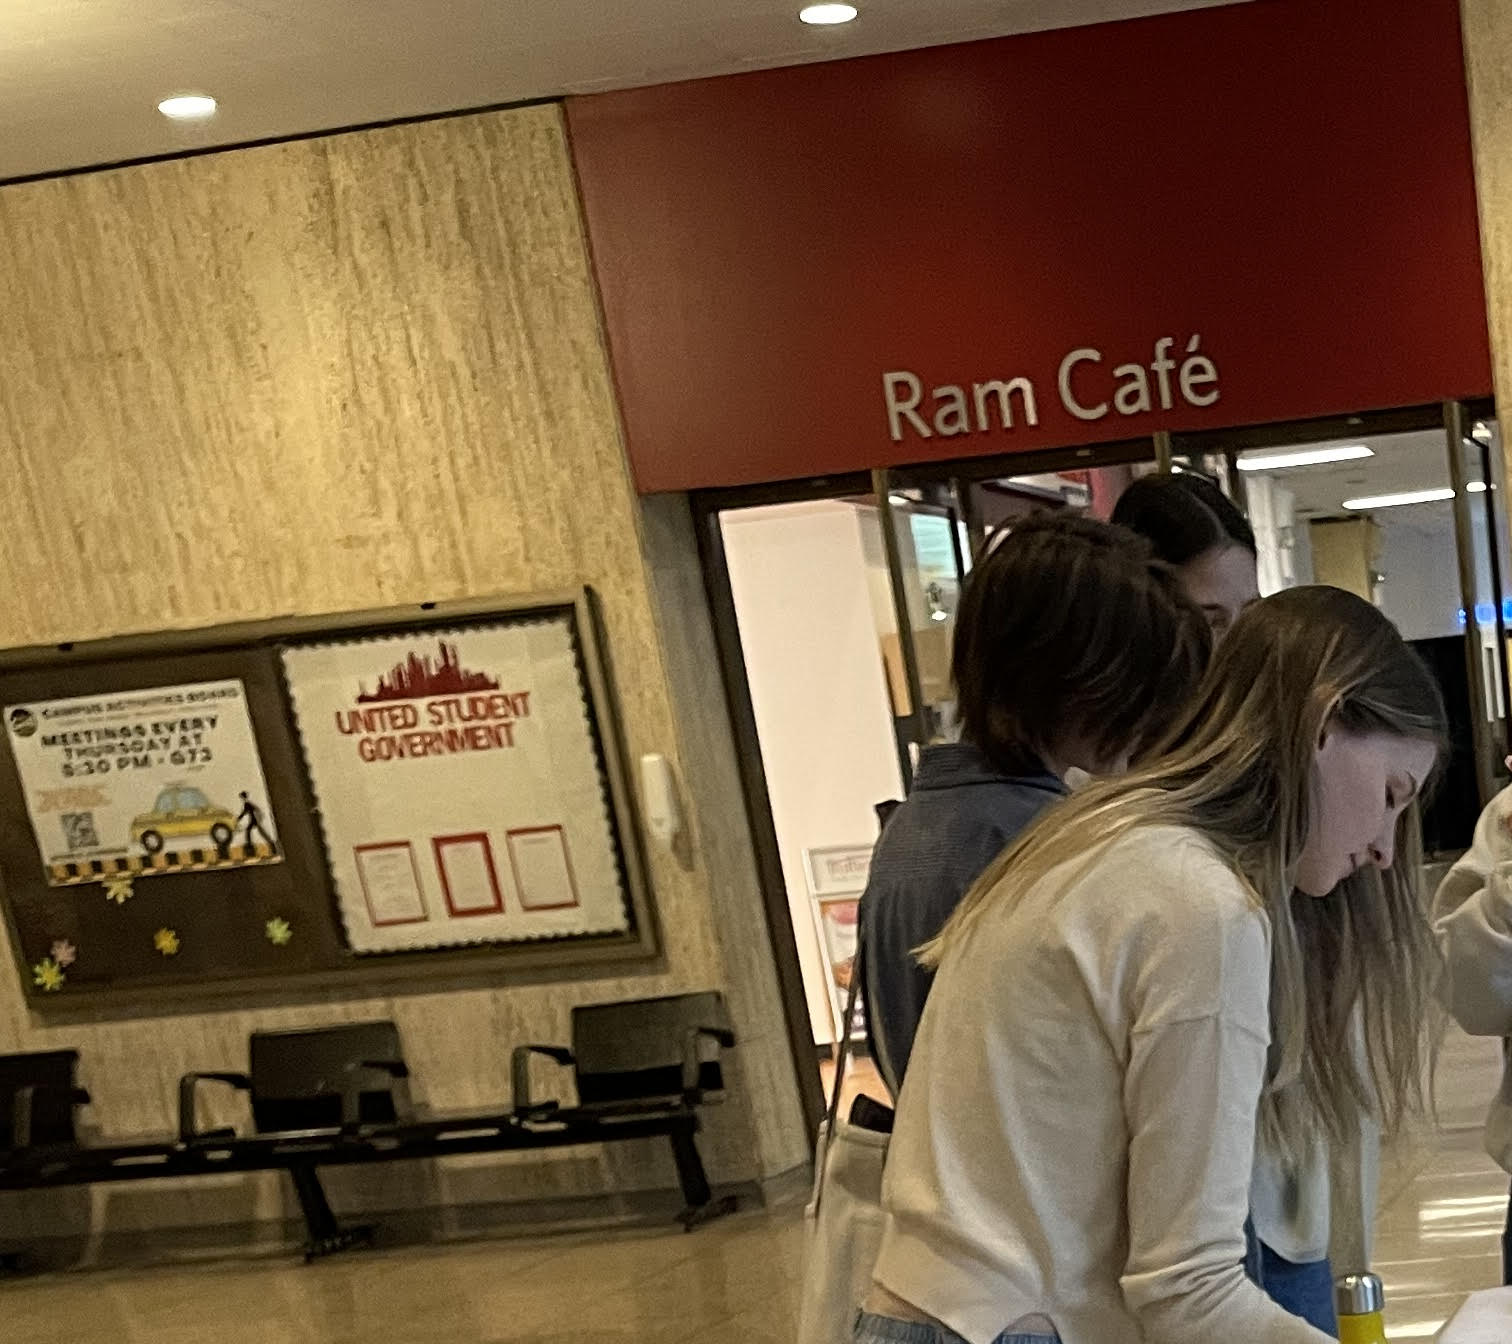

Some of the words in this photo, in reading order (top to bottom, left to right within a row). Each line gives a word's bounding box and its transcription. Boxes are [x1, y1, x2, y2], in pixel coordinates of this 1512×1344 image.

[883, 370, 1038, 440] Ram
[1058, 335, 1220, 419] Café
[41, 725, 147, 747] MEETINGS
[151, 714, 219, 735] EVERY
[336, 704, 418, 735] UNITED
[427, 691, 530, 725] STUDENT
[178, 733, 203, 749] AT
[359, 722, 515, 763] GOVERNMENT
[117, 755, 151, 769] PM
